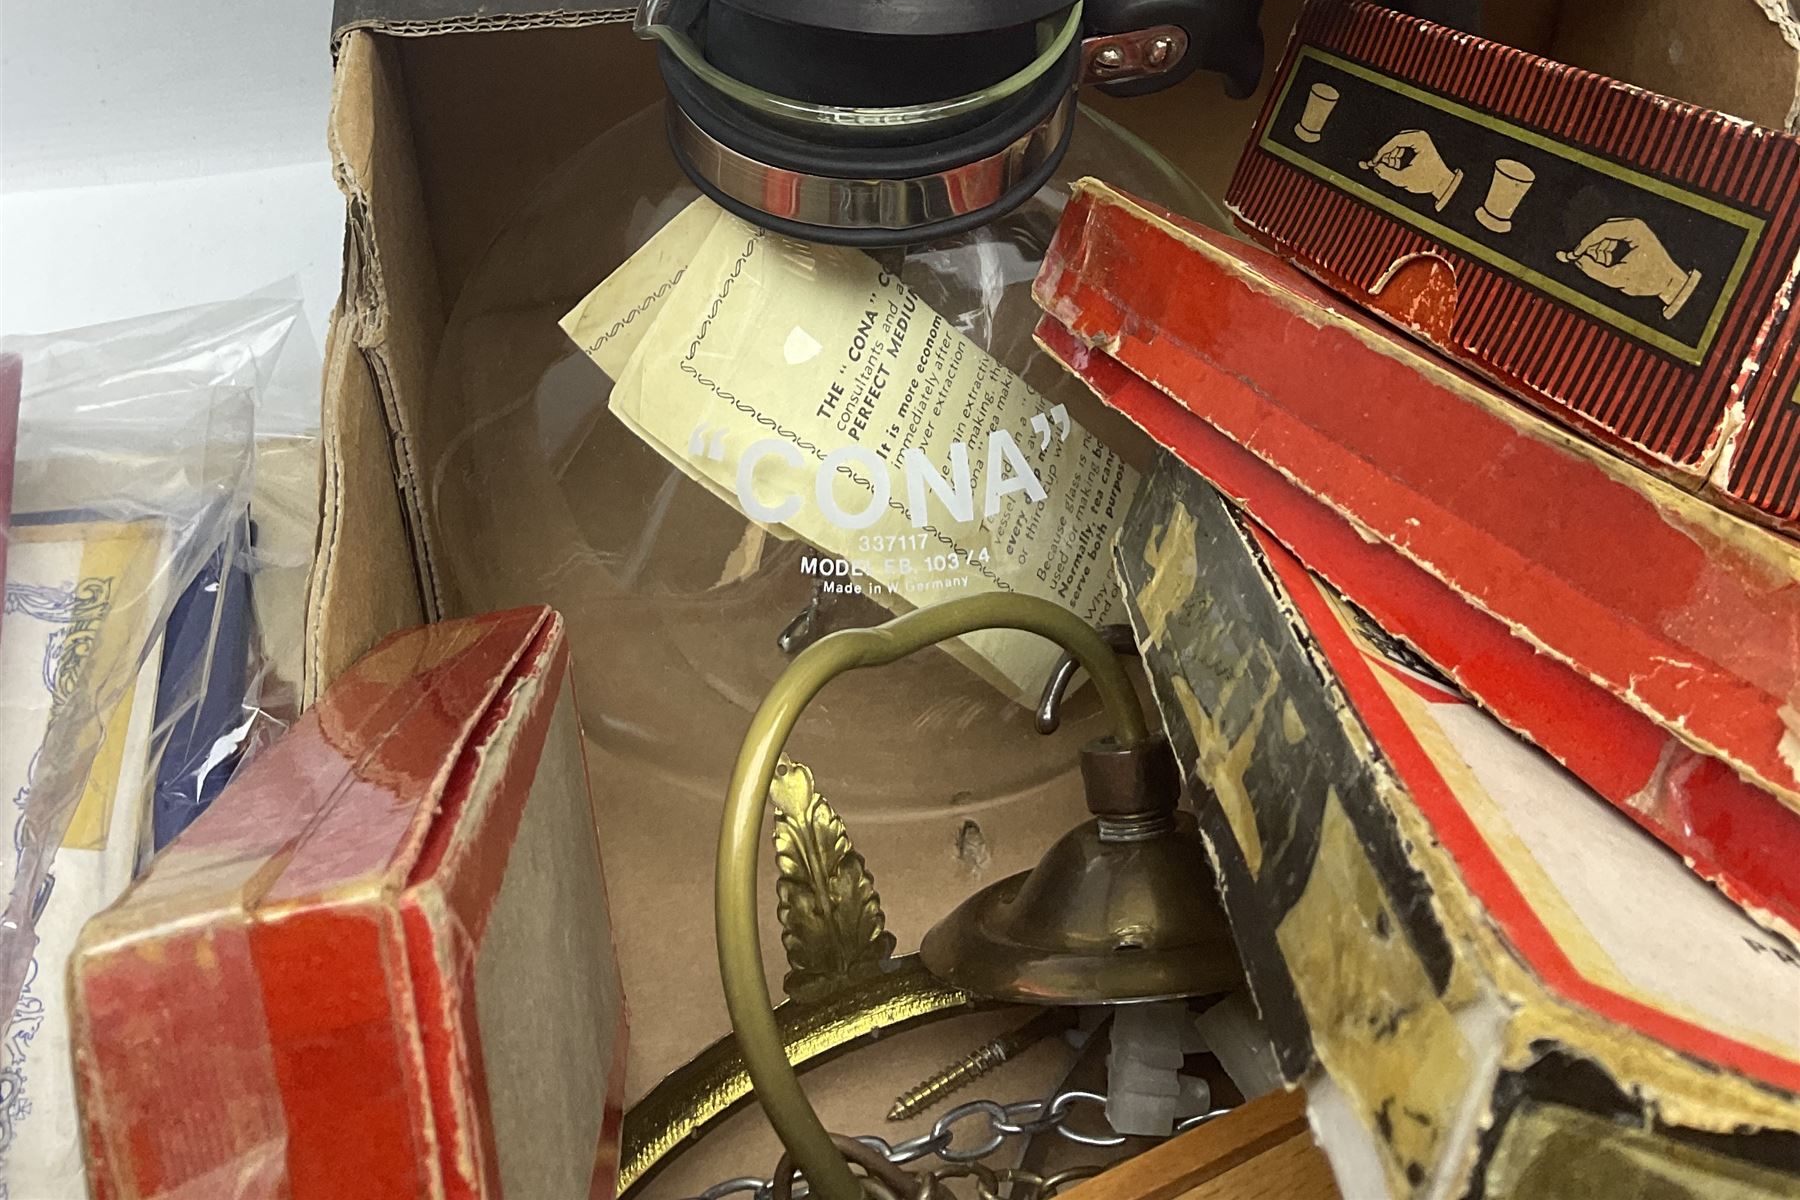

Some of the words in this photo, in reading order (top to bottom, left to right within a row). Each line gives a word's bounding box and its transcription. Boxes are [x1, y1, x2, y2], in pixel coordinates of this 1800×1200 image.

[816, 381, 846, 419] THE
[837, 340, 884, 431] consultants
[882, 300, 899, 333] and
[848, 363, 891, 441] PERFECT
[890, 372, 940, 470] immediately
[935, 330, 953, 371] after
[933, 341, 966, 417] extraction
[875, 442, 892, 460] It
[885, 423, 900, 438] is
[898, 378, 919, 418] more
[858, 533, 929, 552] 337117
[994, 494, 1017, 545] vessel
[1006, 510, 1028, 556] every
[1018, 545, 1028, 565] or
[1036, 515, 1067, 582] Because
[1064, 472, 1082, 513] glass
[1078, 453, 1087, 468] is
[1049, 550, 1069, 590] used
[1066, 525, 1079, 550] for
[1076, 461, 1100, 522] making
[1057, 521, 1097, 599] Normally,
[1090, 489, 1104, 515] tea
[800, 556, 872, 577] MODEL
[823, 580, 862, 594] Made
[869, 582, 882, 594] in
[905, 575, 969, 593] Germany
[1069, 565, 1091, 608] serve
[1088, 524, 1108, 561] both
[1083, 582, 1107, 619] Why
